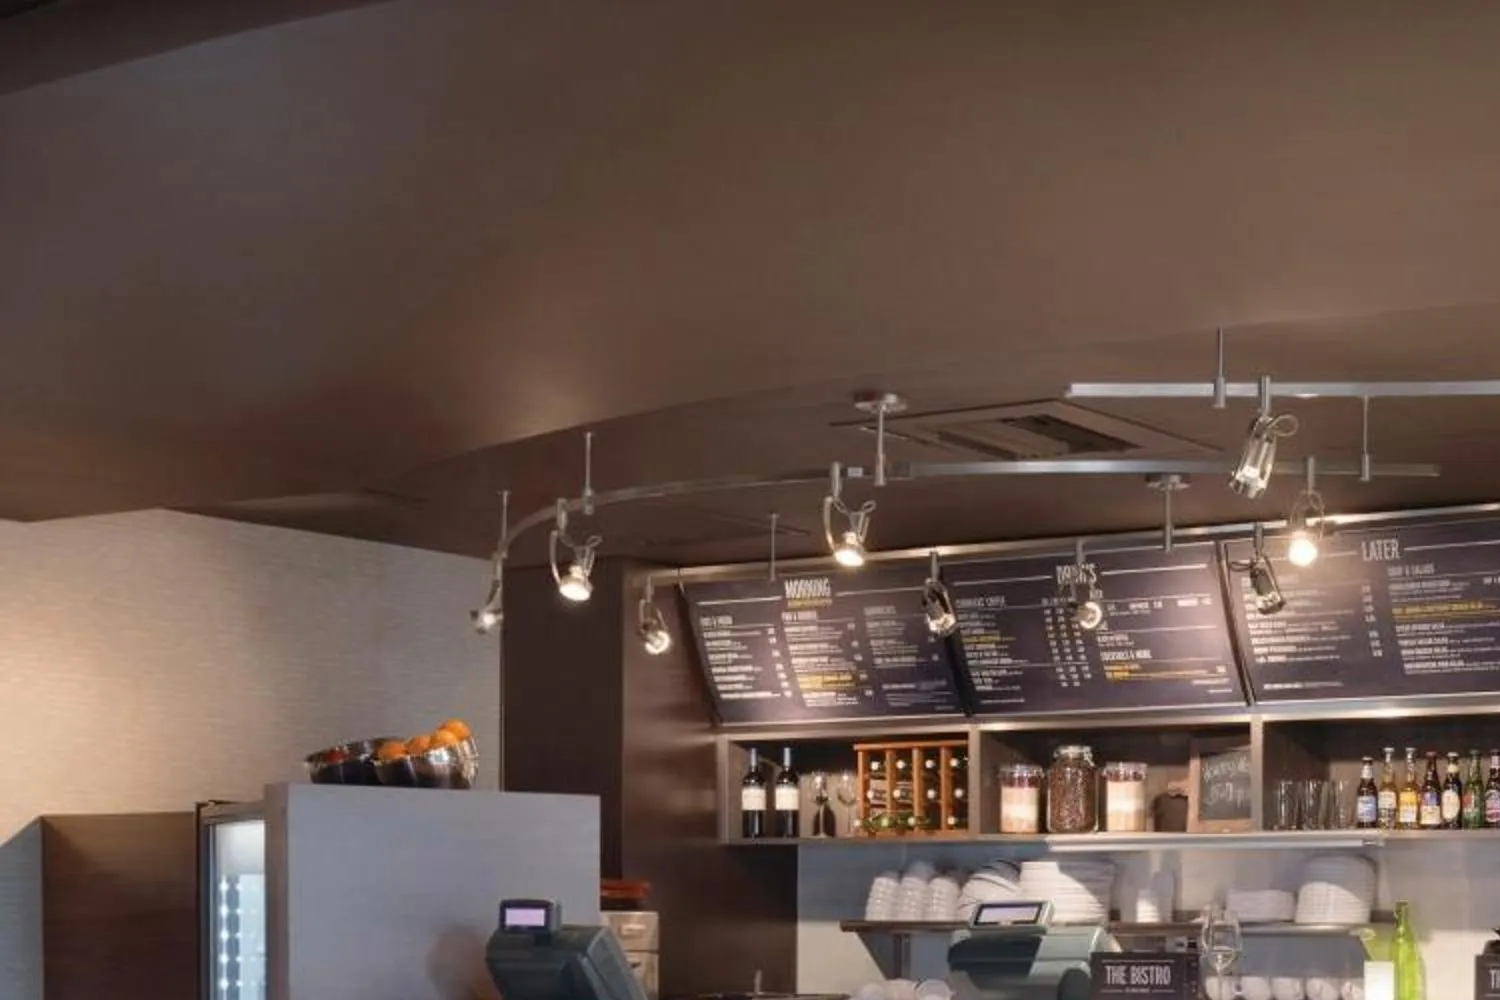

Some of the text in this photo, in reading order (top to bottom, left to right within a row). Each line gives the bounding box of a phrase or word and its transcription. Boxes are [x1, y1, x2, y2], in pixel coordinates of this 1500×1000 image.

[1361, 538, 1400, 561] LATER
[784, 578, 831, 599] MORNING
[1105, 965, 1171, 985] THE BISTRO
